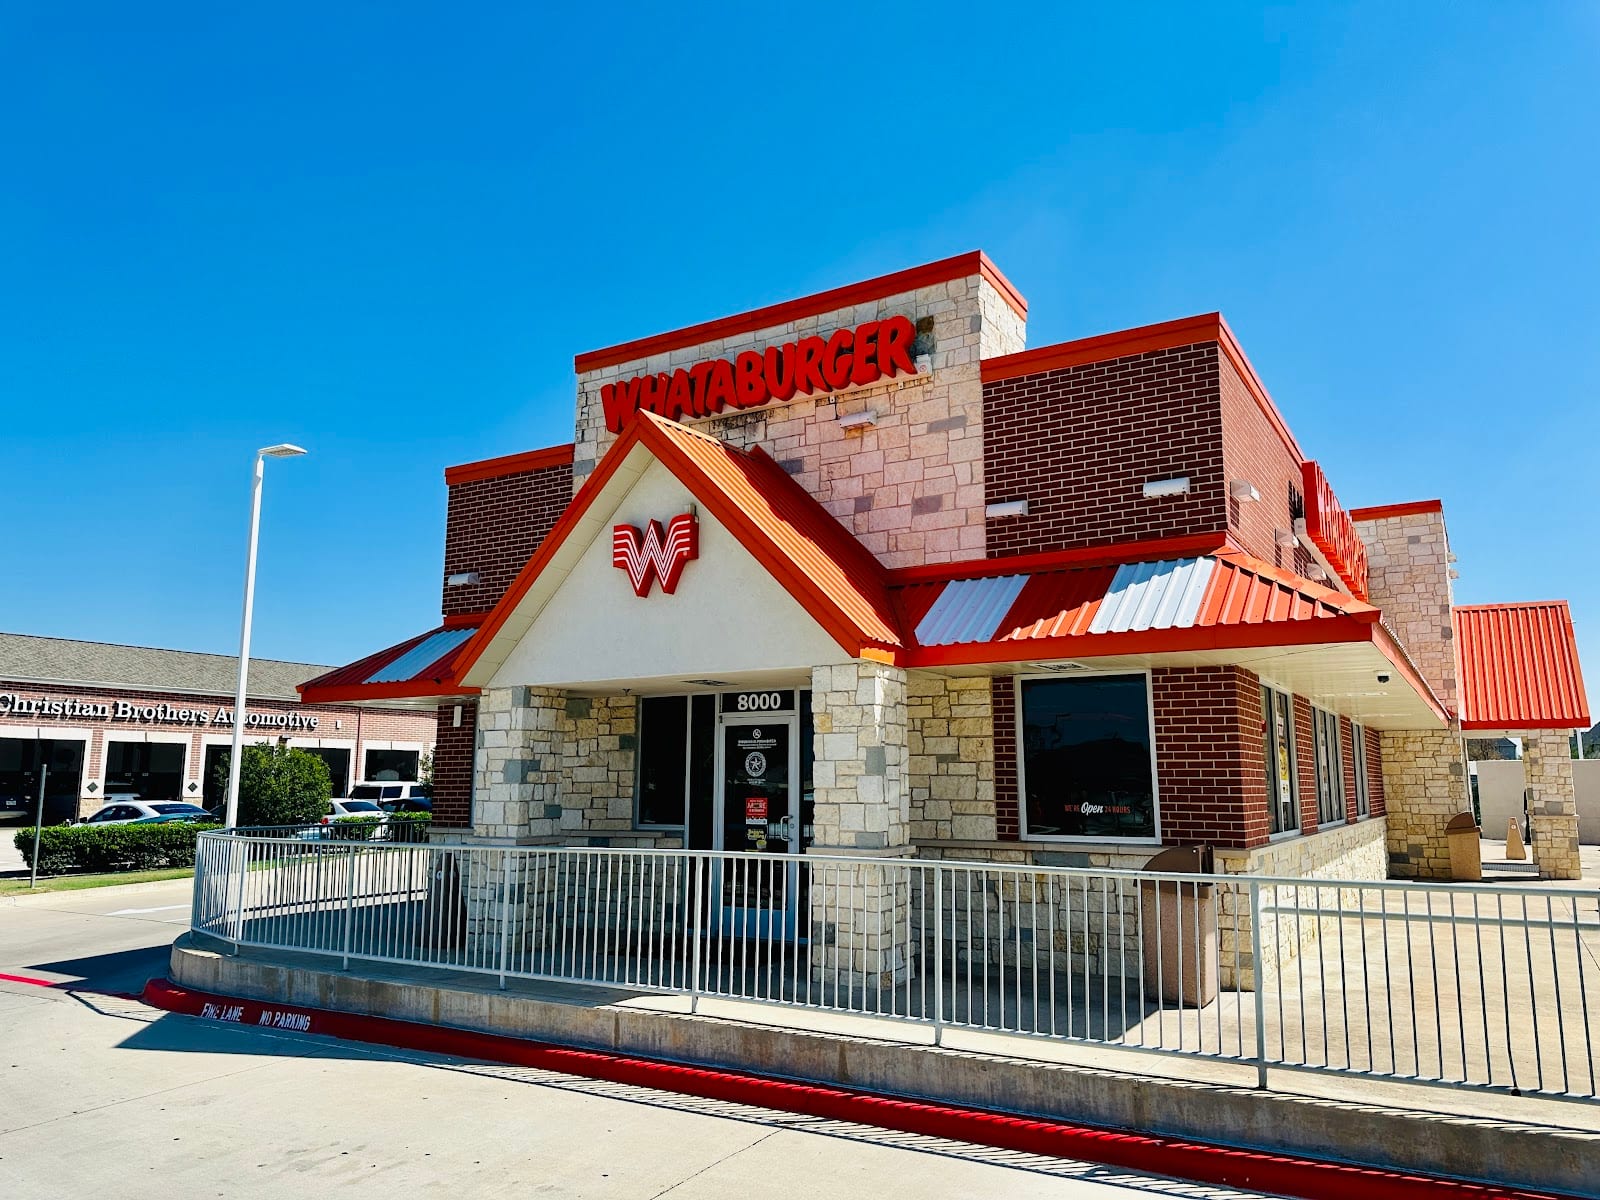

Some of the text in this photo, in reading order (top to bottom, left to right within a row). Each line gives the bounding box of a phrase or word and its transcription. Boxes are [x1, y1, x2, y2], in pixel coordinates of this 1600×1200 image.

[600, 315, 917, 434] WHATABURGER
[612, 513, 700, 598] W
[0, 693, 109, 717] Christian
[115, 701, 209, 722] Brothers
[738, 692, 780, 710] 8000
[1080, 801, 1104, 816] Open
[221, 1004, 244, 1021] LANE
[259, 1010, 311, 1031] NO PARKING
